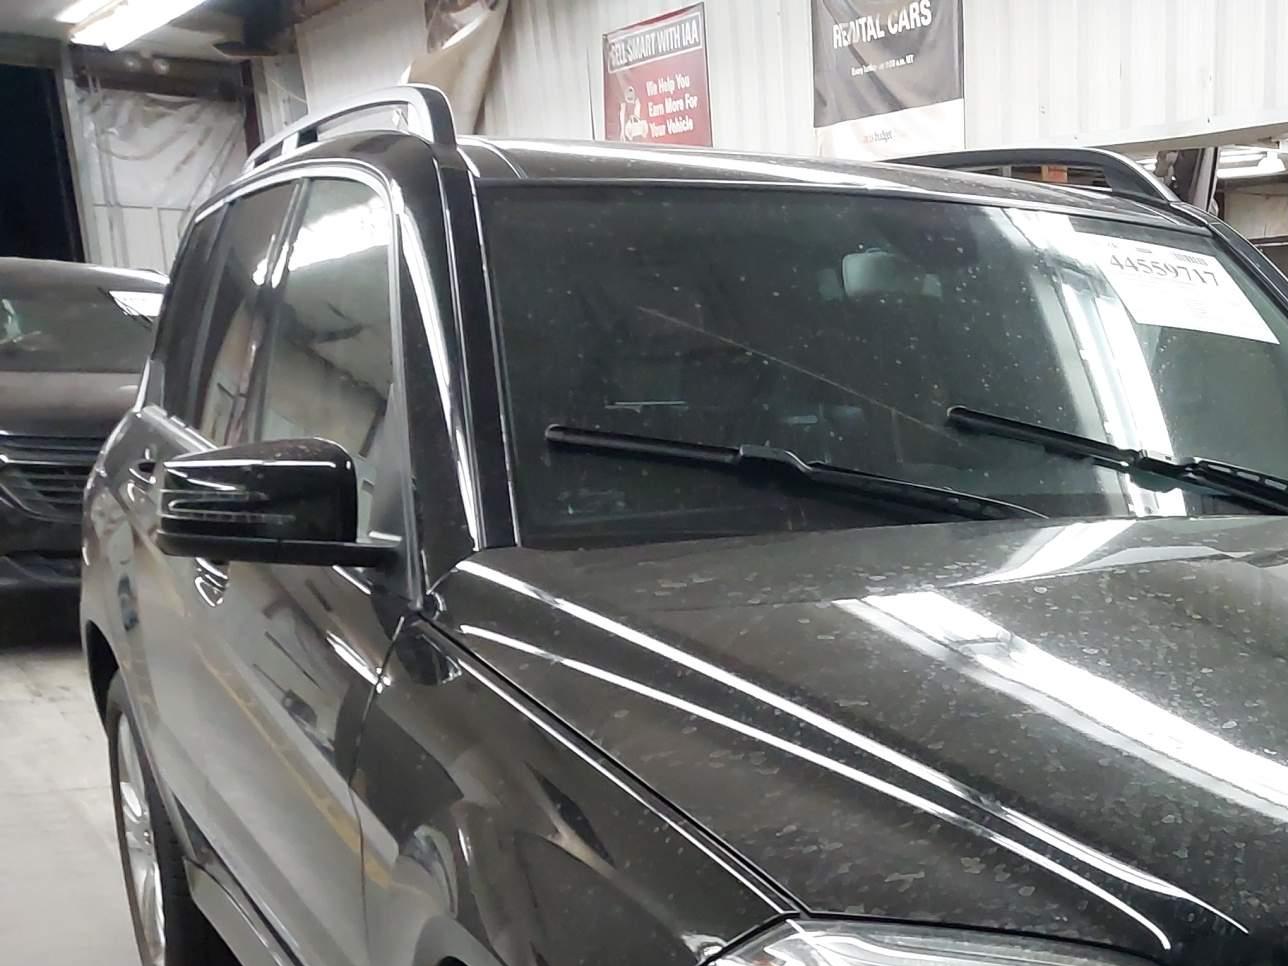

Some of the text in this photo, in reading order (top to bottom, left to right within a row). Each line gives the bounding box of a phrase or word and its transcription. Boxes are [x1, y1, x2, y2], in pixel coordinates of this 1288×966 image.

[832, 0, 932, 49] RENTAL CARS
[627, 32, 656, 62] SMART
[656, 24, 681, 53] WITH
[681, 19, 699, 46] IAA
[646, 73, 690, 97] We Help You
[648, 93, 698, 117] Earn More For
[649, 115, 693, 138] Your Vehicle
[1109, 254, 1220, 286] 44559717
